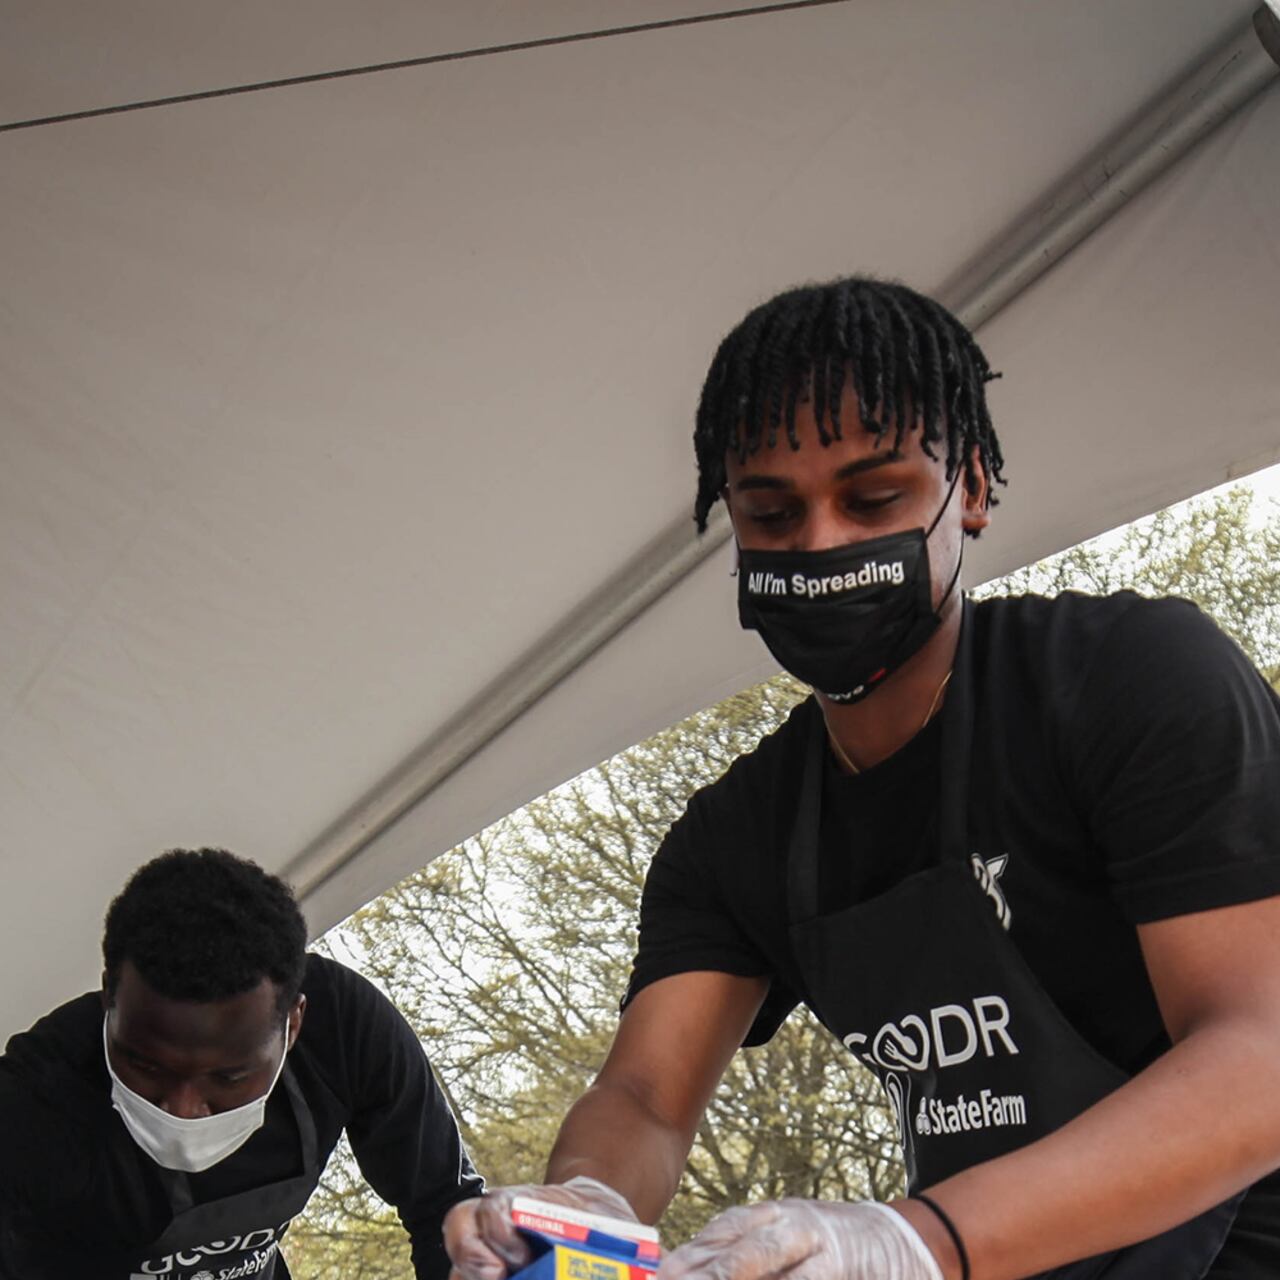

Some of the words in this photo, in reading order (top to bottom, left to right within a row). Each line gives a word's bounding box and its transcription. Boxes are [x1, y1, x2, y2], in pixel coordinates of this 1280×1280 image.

[748, 572, 764, 594] All
[764, 572, 787, 595] I'm
[791, 560, 905, 598] Spreading
